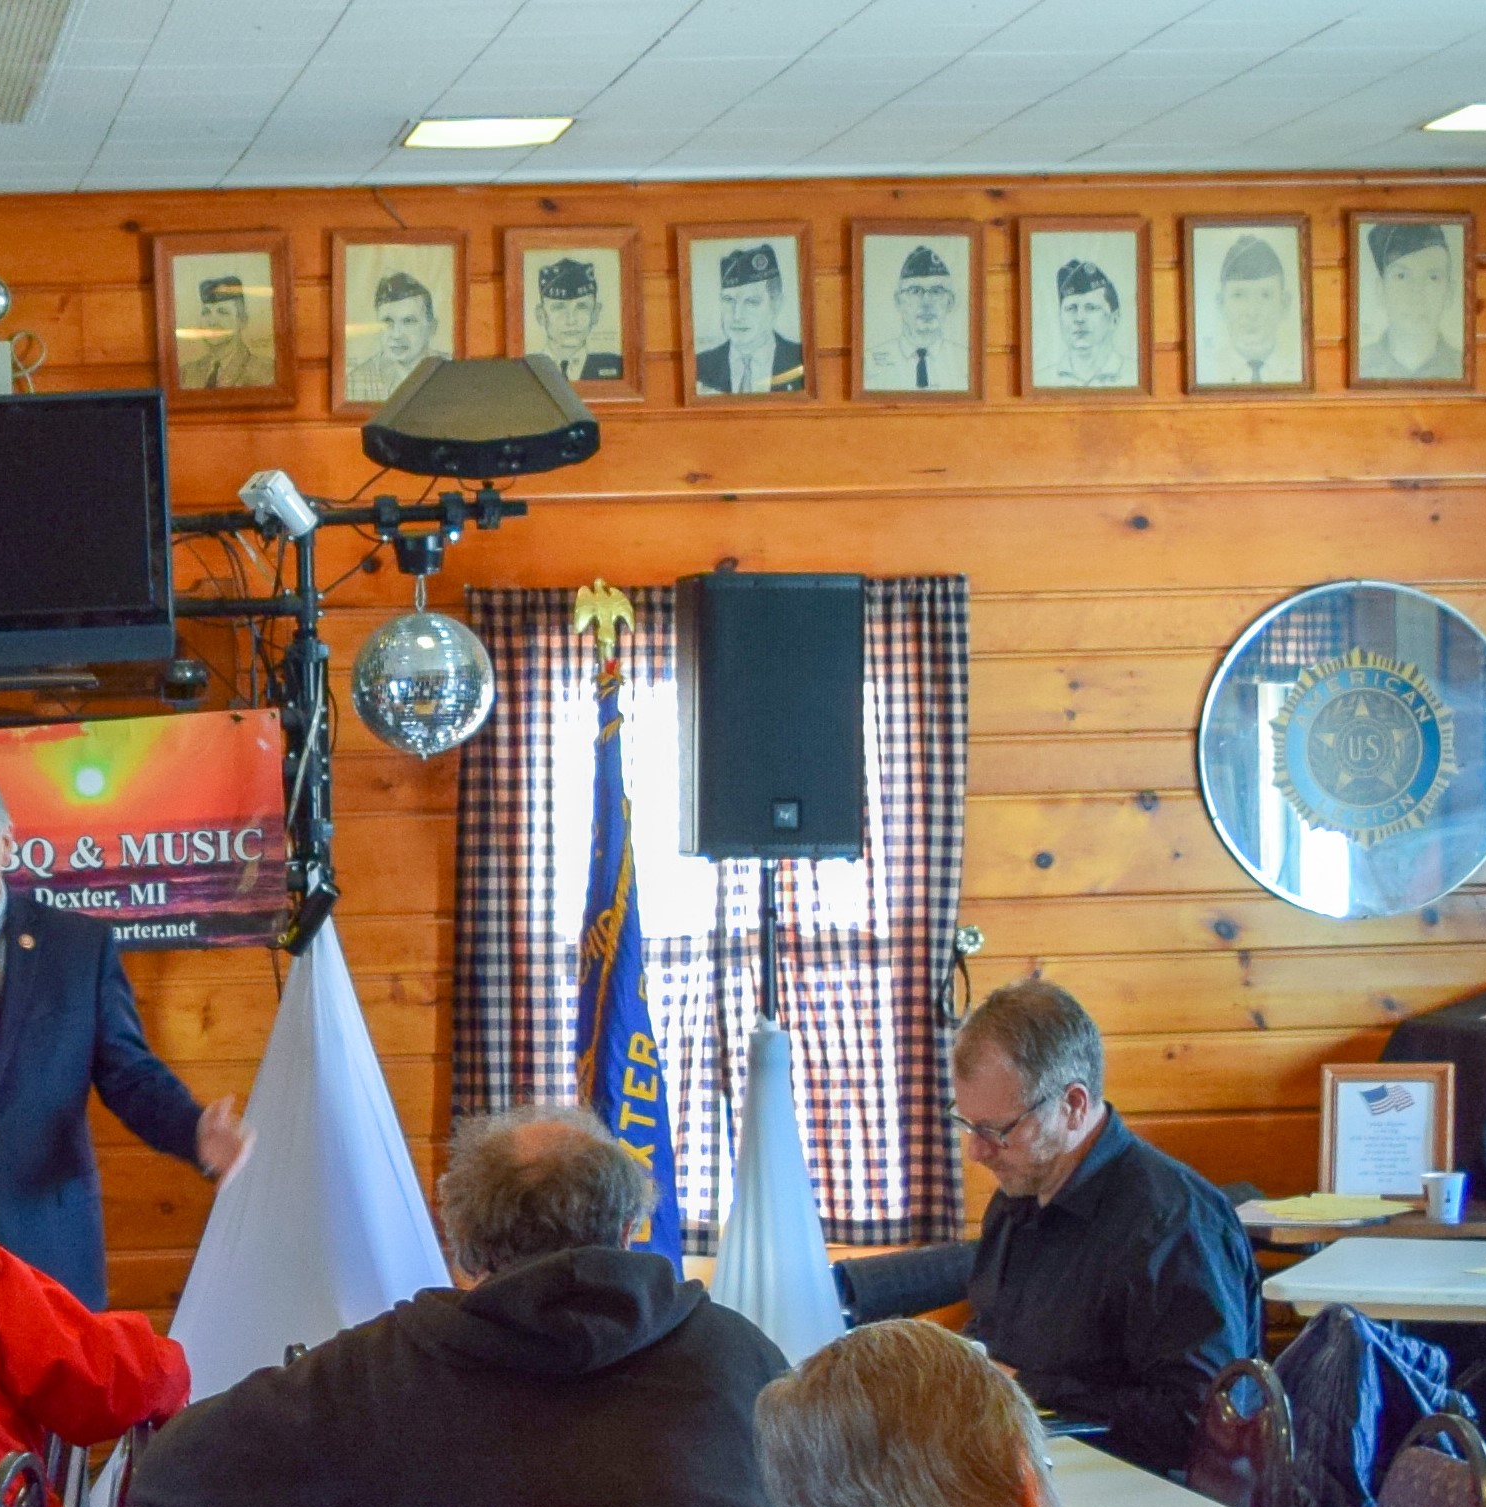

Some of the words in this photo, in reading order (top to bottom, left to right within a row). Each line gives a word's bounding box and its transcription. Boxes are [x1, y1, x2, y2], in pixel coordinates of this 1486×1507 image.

[1349, 735, 1380, 761] US
[0, 838, 55, 877] BQ
[69, 836, 104, 869] &
[119, 828, 263, 867] MUSIC
[34, 888, 121, 910] Dexter,
[130, 882, 167, 905] MI
[113, 920, 197, 941] arter.net
[618, 1030, 658, 1242] XTER
